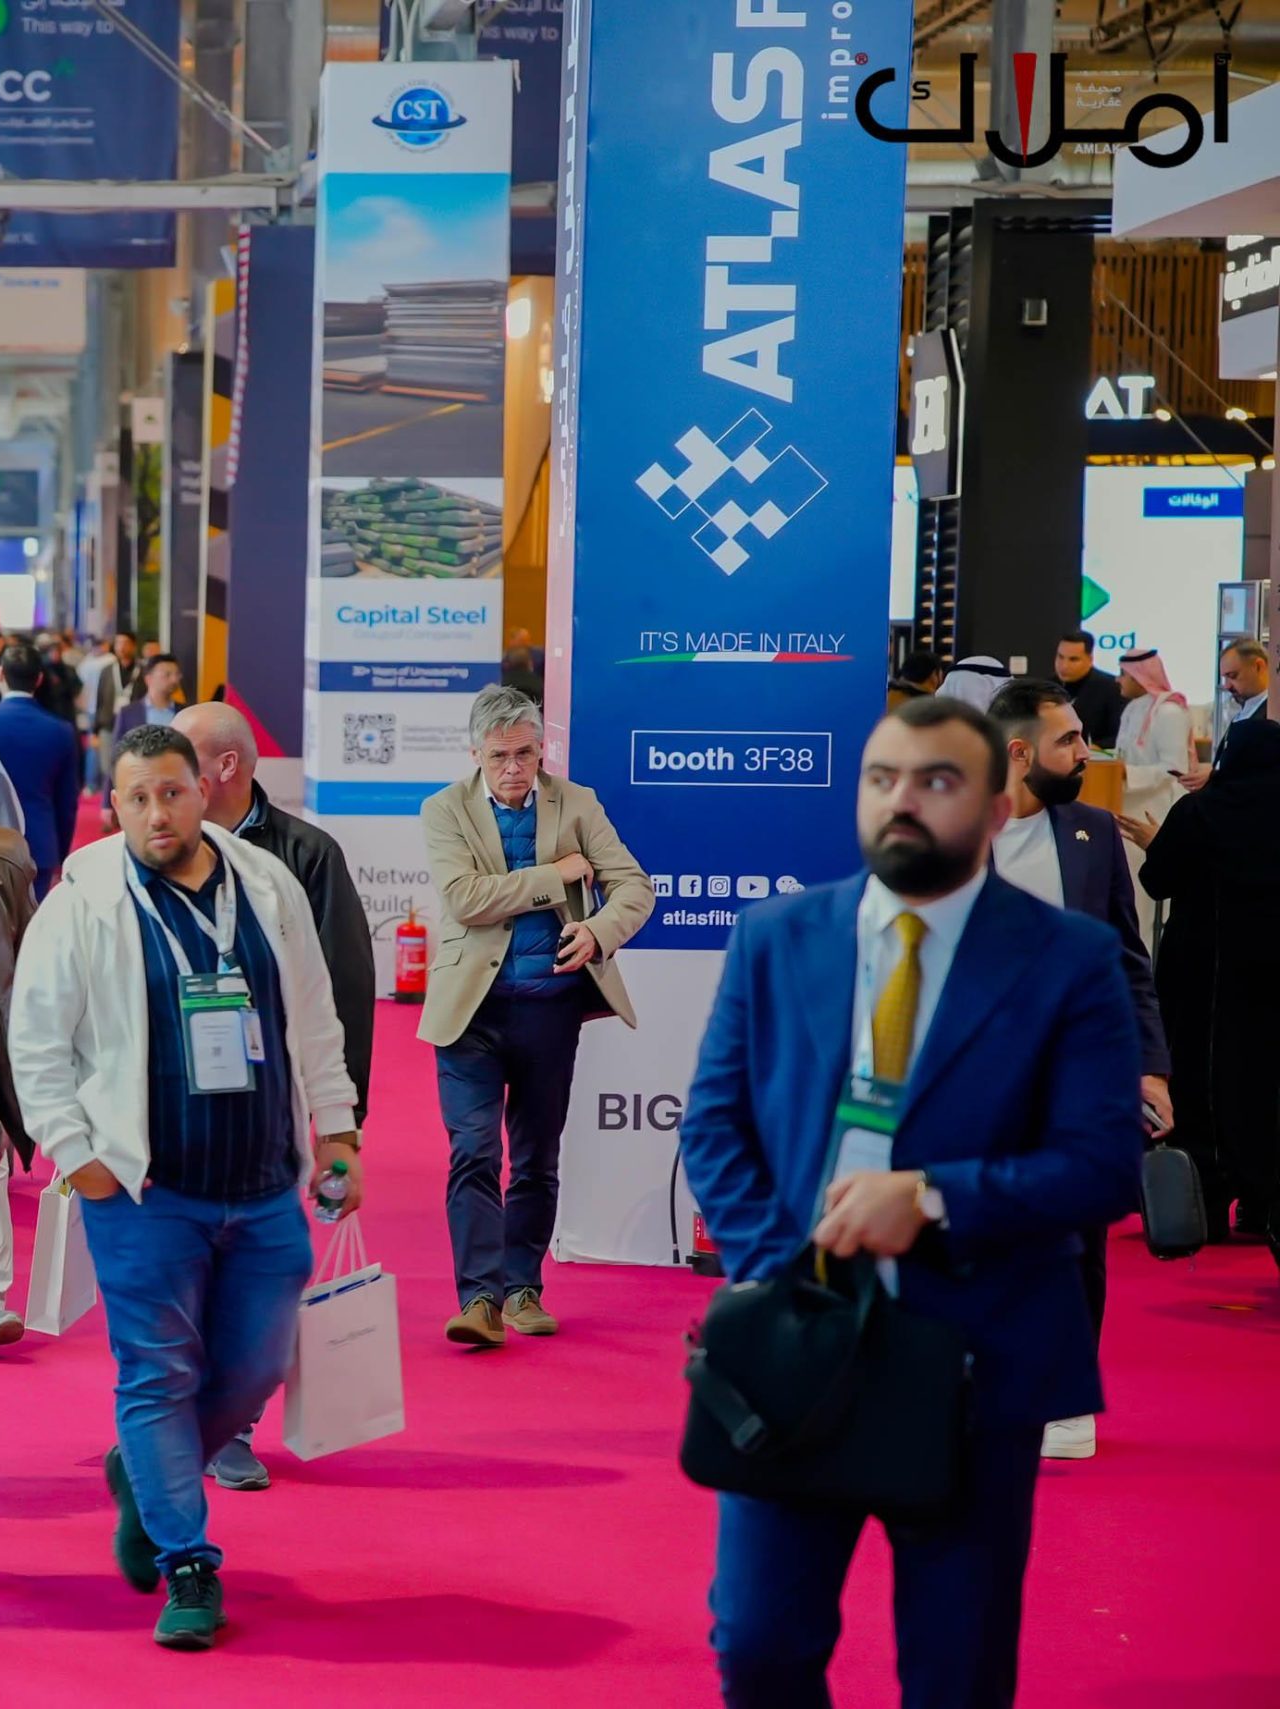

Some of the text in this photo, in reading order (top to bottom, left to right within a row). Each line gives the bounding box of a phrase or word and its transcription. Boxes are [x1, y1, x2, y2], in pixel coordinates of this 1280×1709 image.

[22, 17, 57, 33] This
[60, 21, 94, 37] way
[396, 99, 442, 121] CST
[336, 604, 488, 627] Capital Steel
[639, 631, 846, 653] IT'S MADE IN ITALY
[648, 746, 814, 772] booth 3F38
[361, 895, 413, 913] Build
[597, 1093, 683, 1132] BIG
